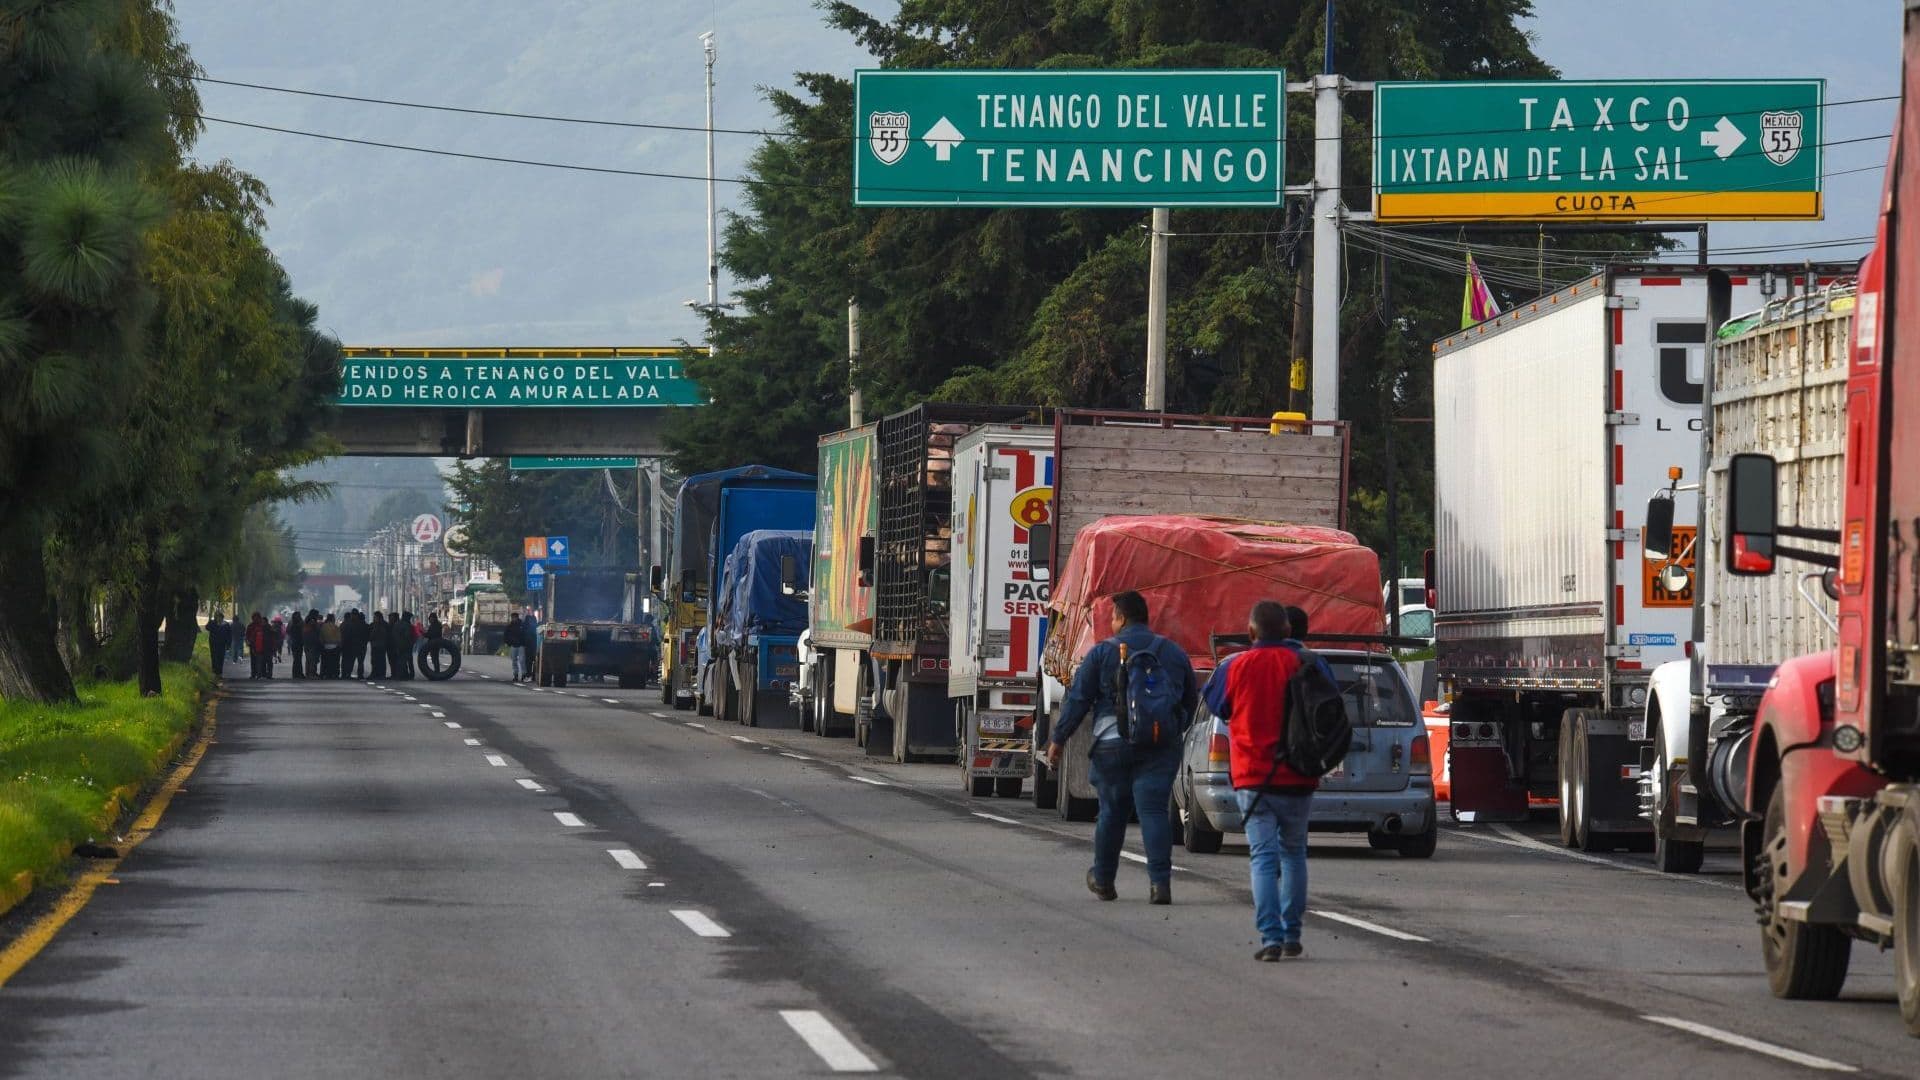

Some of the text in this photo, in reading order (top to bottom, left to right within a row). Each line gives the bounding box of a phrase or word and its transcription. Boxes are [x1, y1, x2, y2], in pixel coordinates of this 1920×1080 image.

[977, 94, 1267, 129] TENANGO DEL VALLE
[1519, 96, 1690, 132] TAXCO
[874, 116, 905, 126] MEXICO
[1765, 116, 1798, 127] MEXICO
[880, 130, 899, 152] 55
[1772, 130, 1791, 152] 55
[976, 148, 1267, 183] TENANCINGO
[1391, 146, 1689, 182] IXTAPAN DE LA SAL
[1778, 154, 1784, 163] D
[1555, 195, 1637, 211] CUOTA
[440, 367, 452, 380] A
[464, 366, 565, 380] TENANGO
[575, 366, 614, 380] DEL
[404, 385, 497, 399] HEROICA
[509, 385, 660, 399] AMURALLADA
[1631, 634, 1676, 646] STOUGHTON
